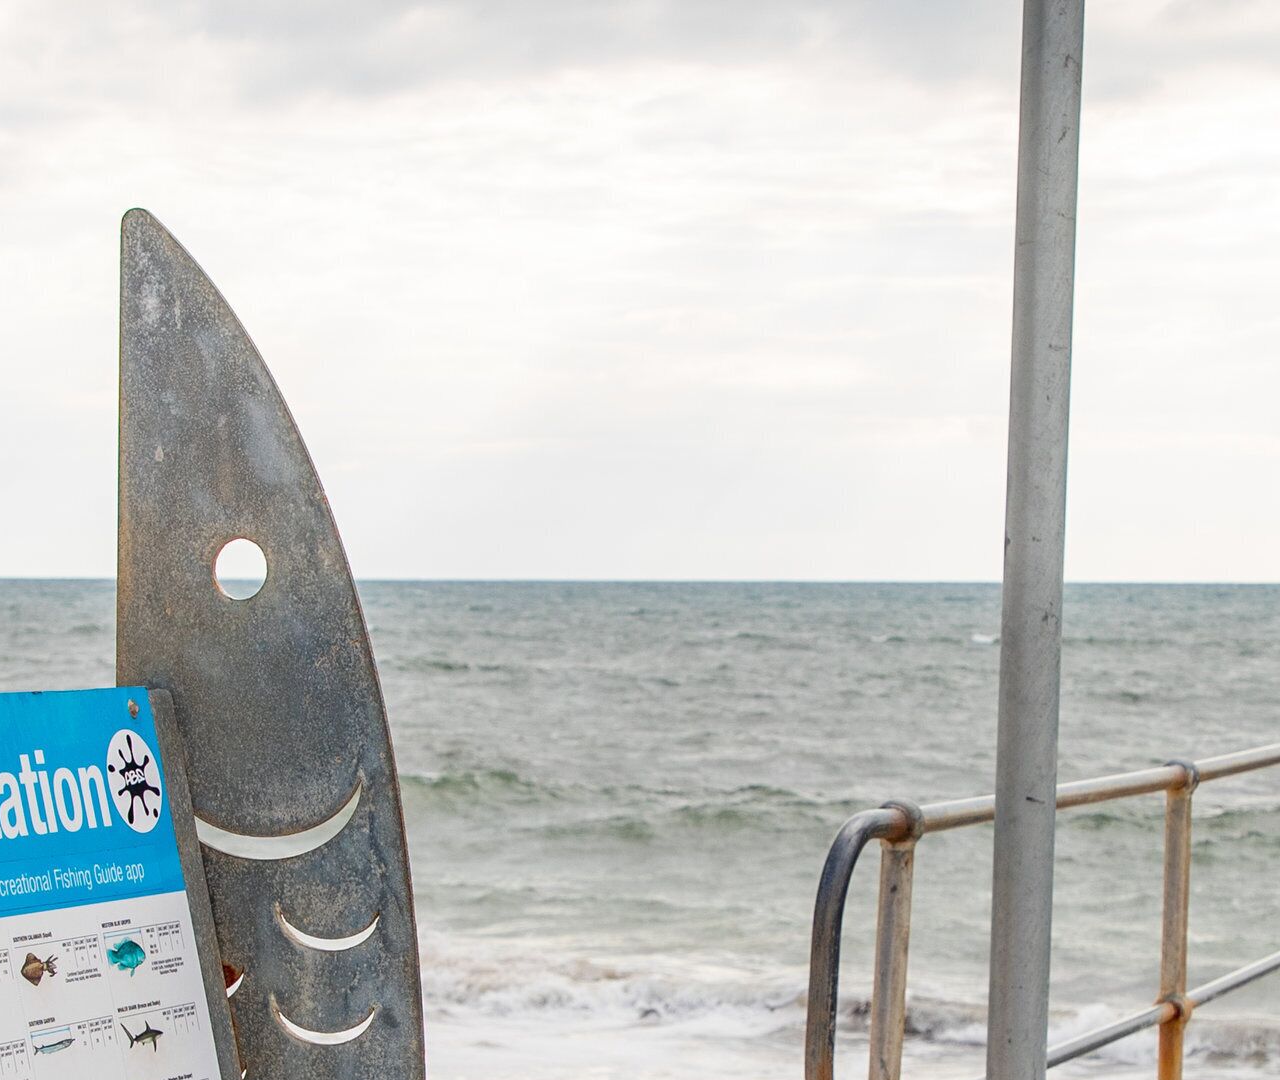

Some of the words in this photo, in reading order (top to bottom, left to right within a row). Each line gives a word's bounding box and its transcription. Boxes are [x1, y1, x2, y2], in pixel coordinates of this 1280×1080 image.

[54, 867, 94, 891] Fishing
[94, 862, 124, 884] Guide
[126, 862, 145, 884] app
